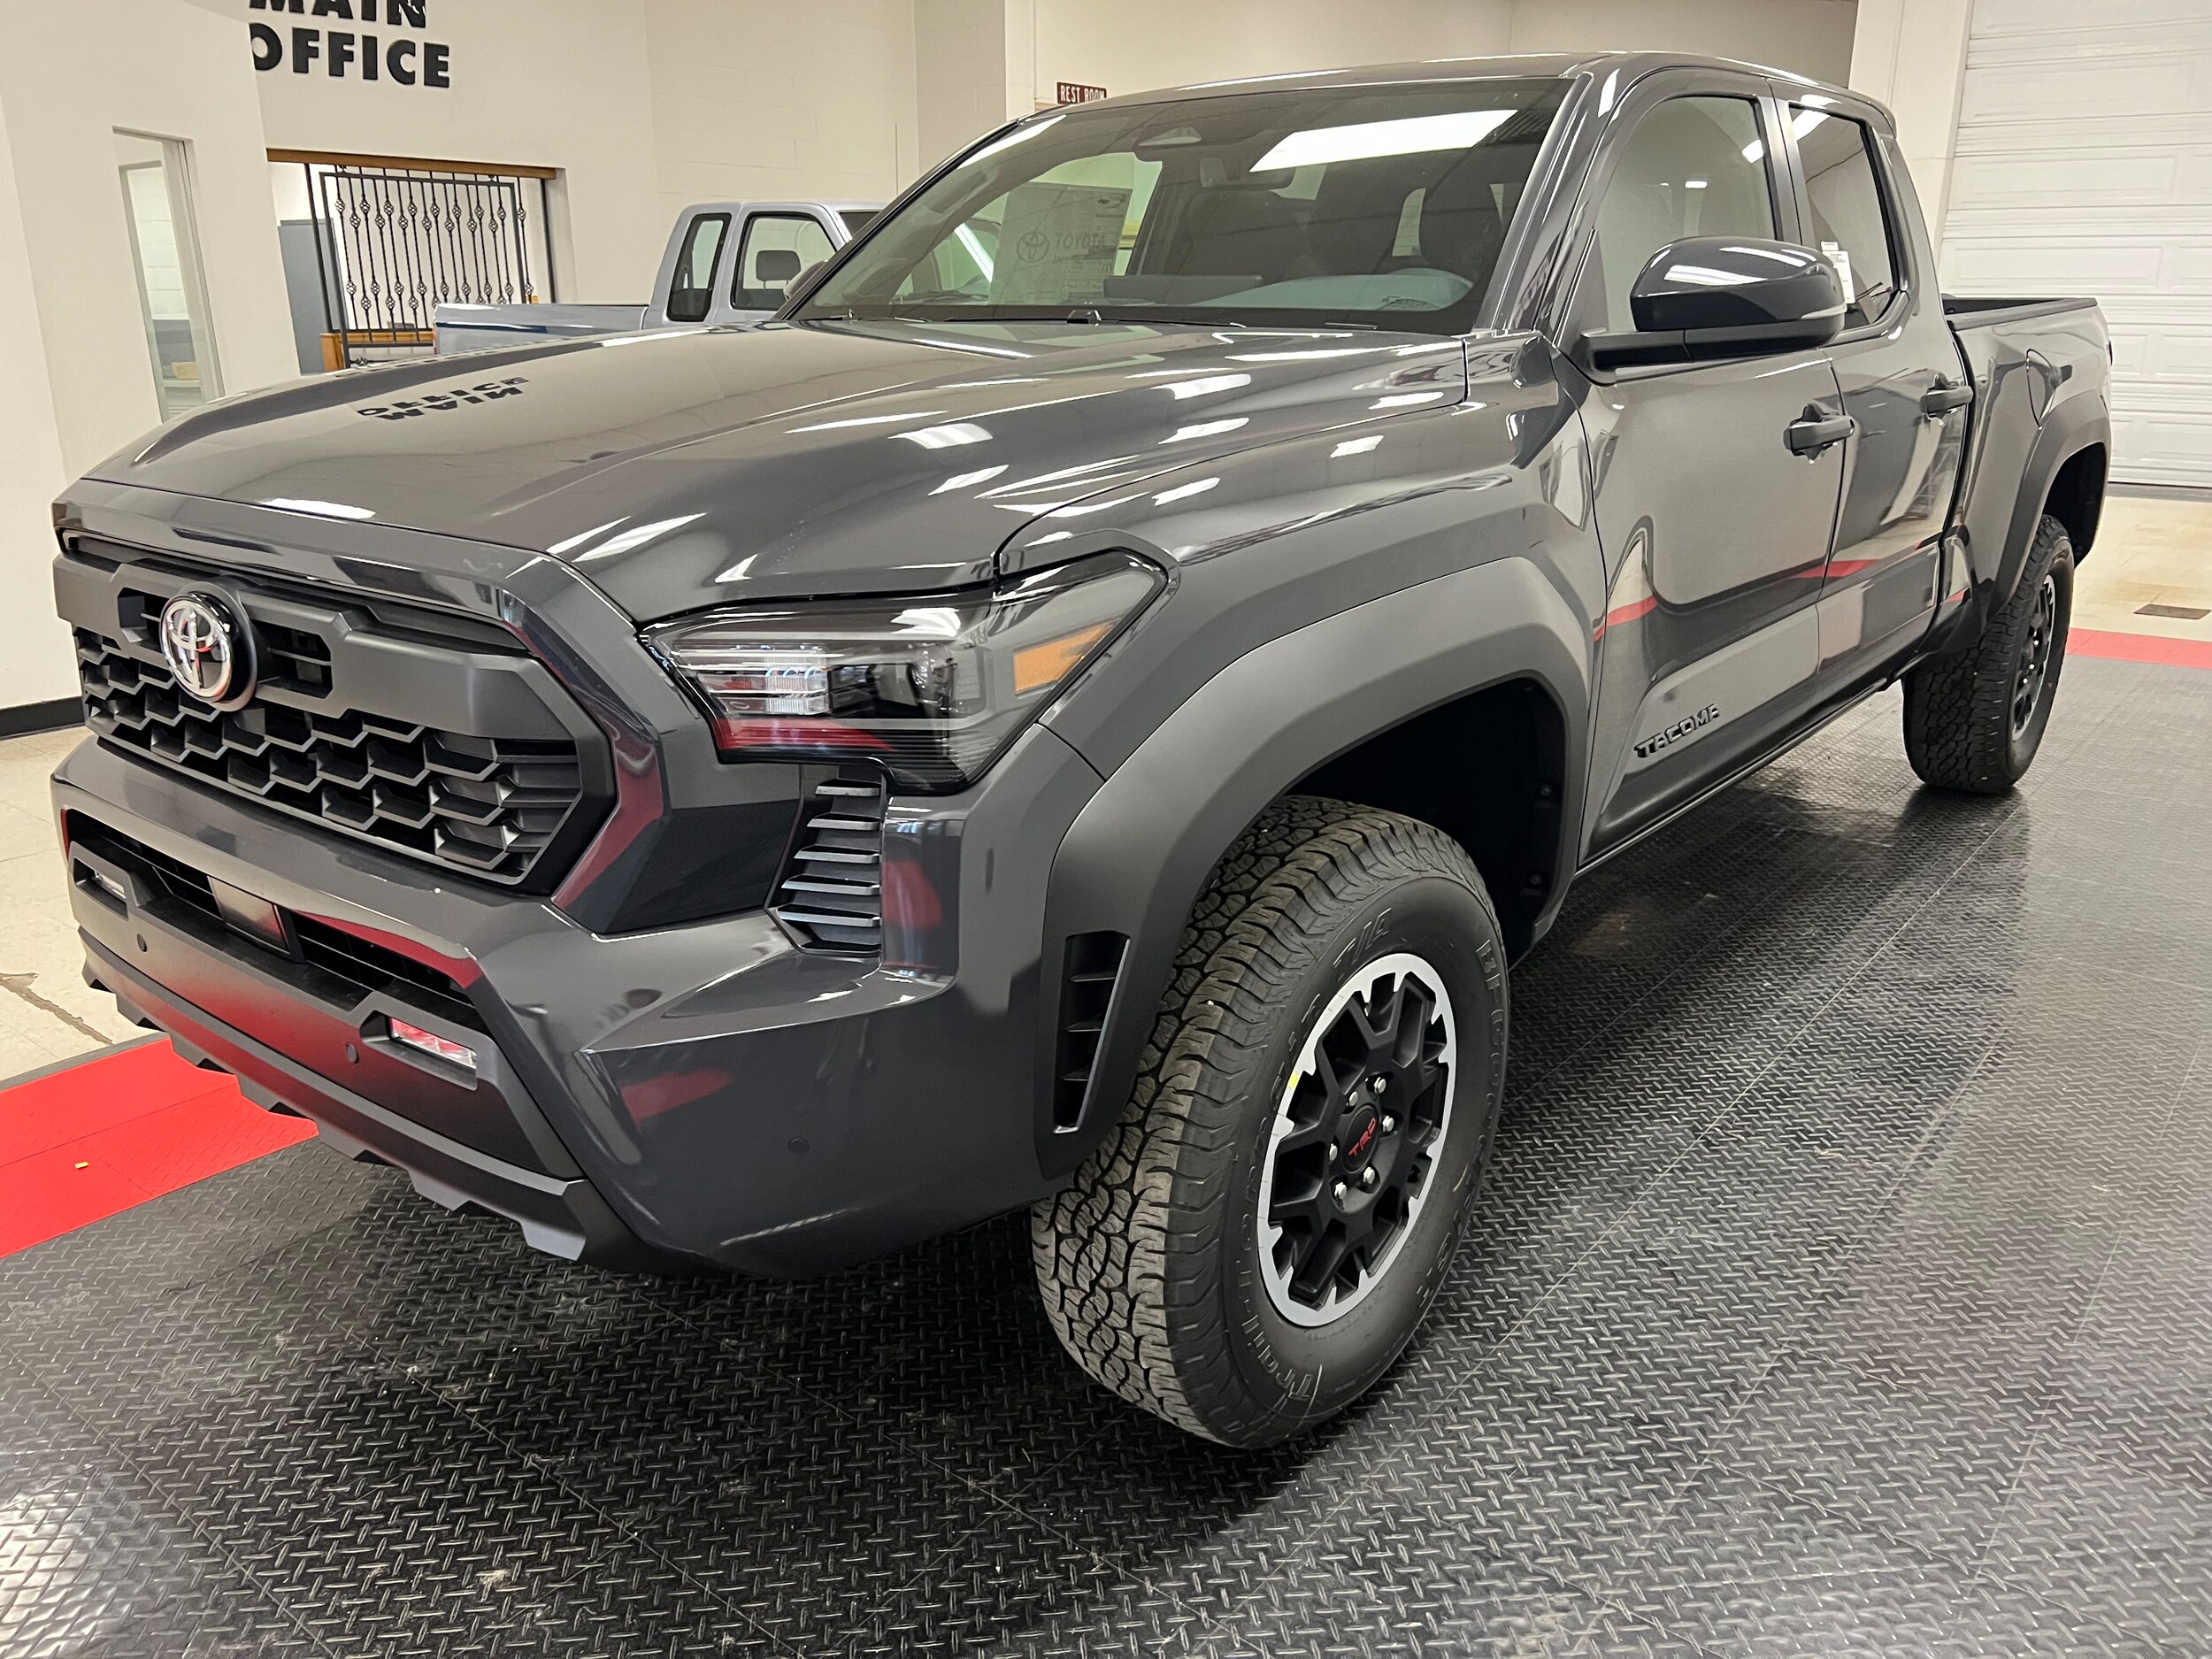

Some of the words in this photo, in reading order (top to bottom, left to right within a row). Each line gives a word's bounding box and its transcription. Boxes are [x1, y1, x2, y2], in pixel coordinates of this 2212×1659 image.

[249, 0, 426, 28] IN
[249, 22, 449, 88] OFFICE
[1060, 84, 1080, 104] REST
[1084, 88, 1105, 103] ROOM
[1634, 703, 1721, 758] TACOMA
[1347, 1117, 1377, 1156] TRD
